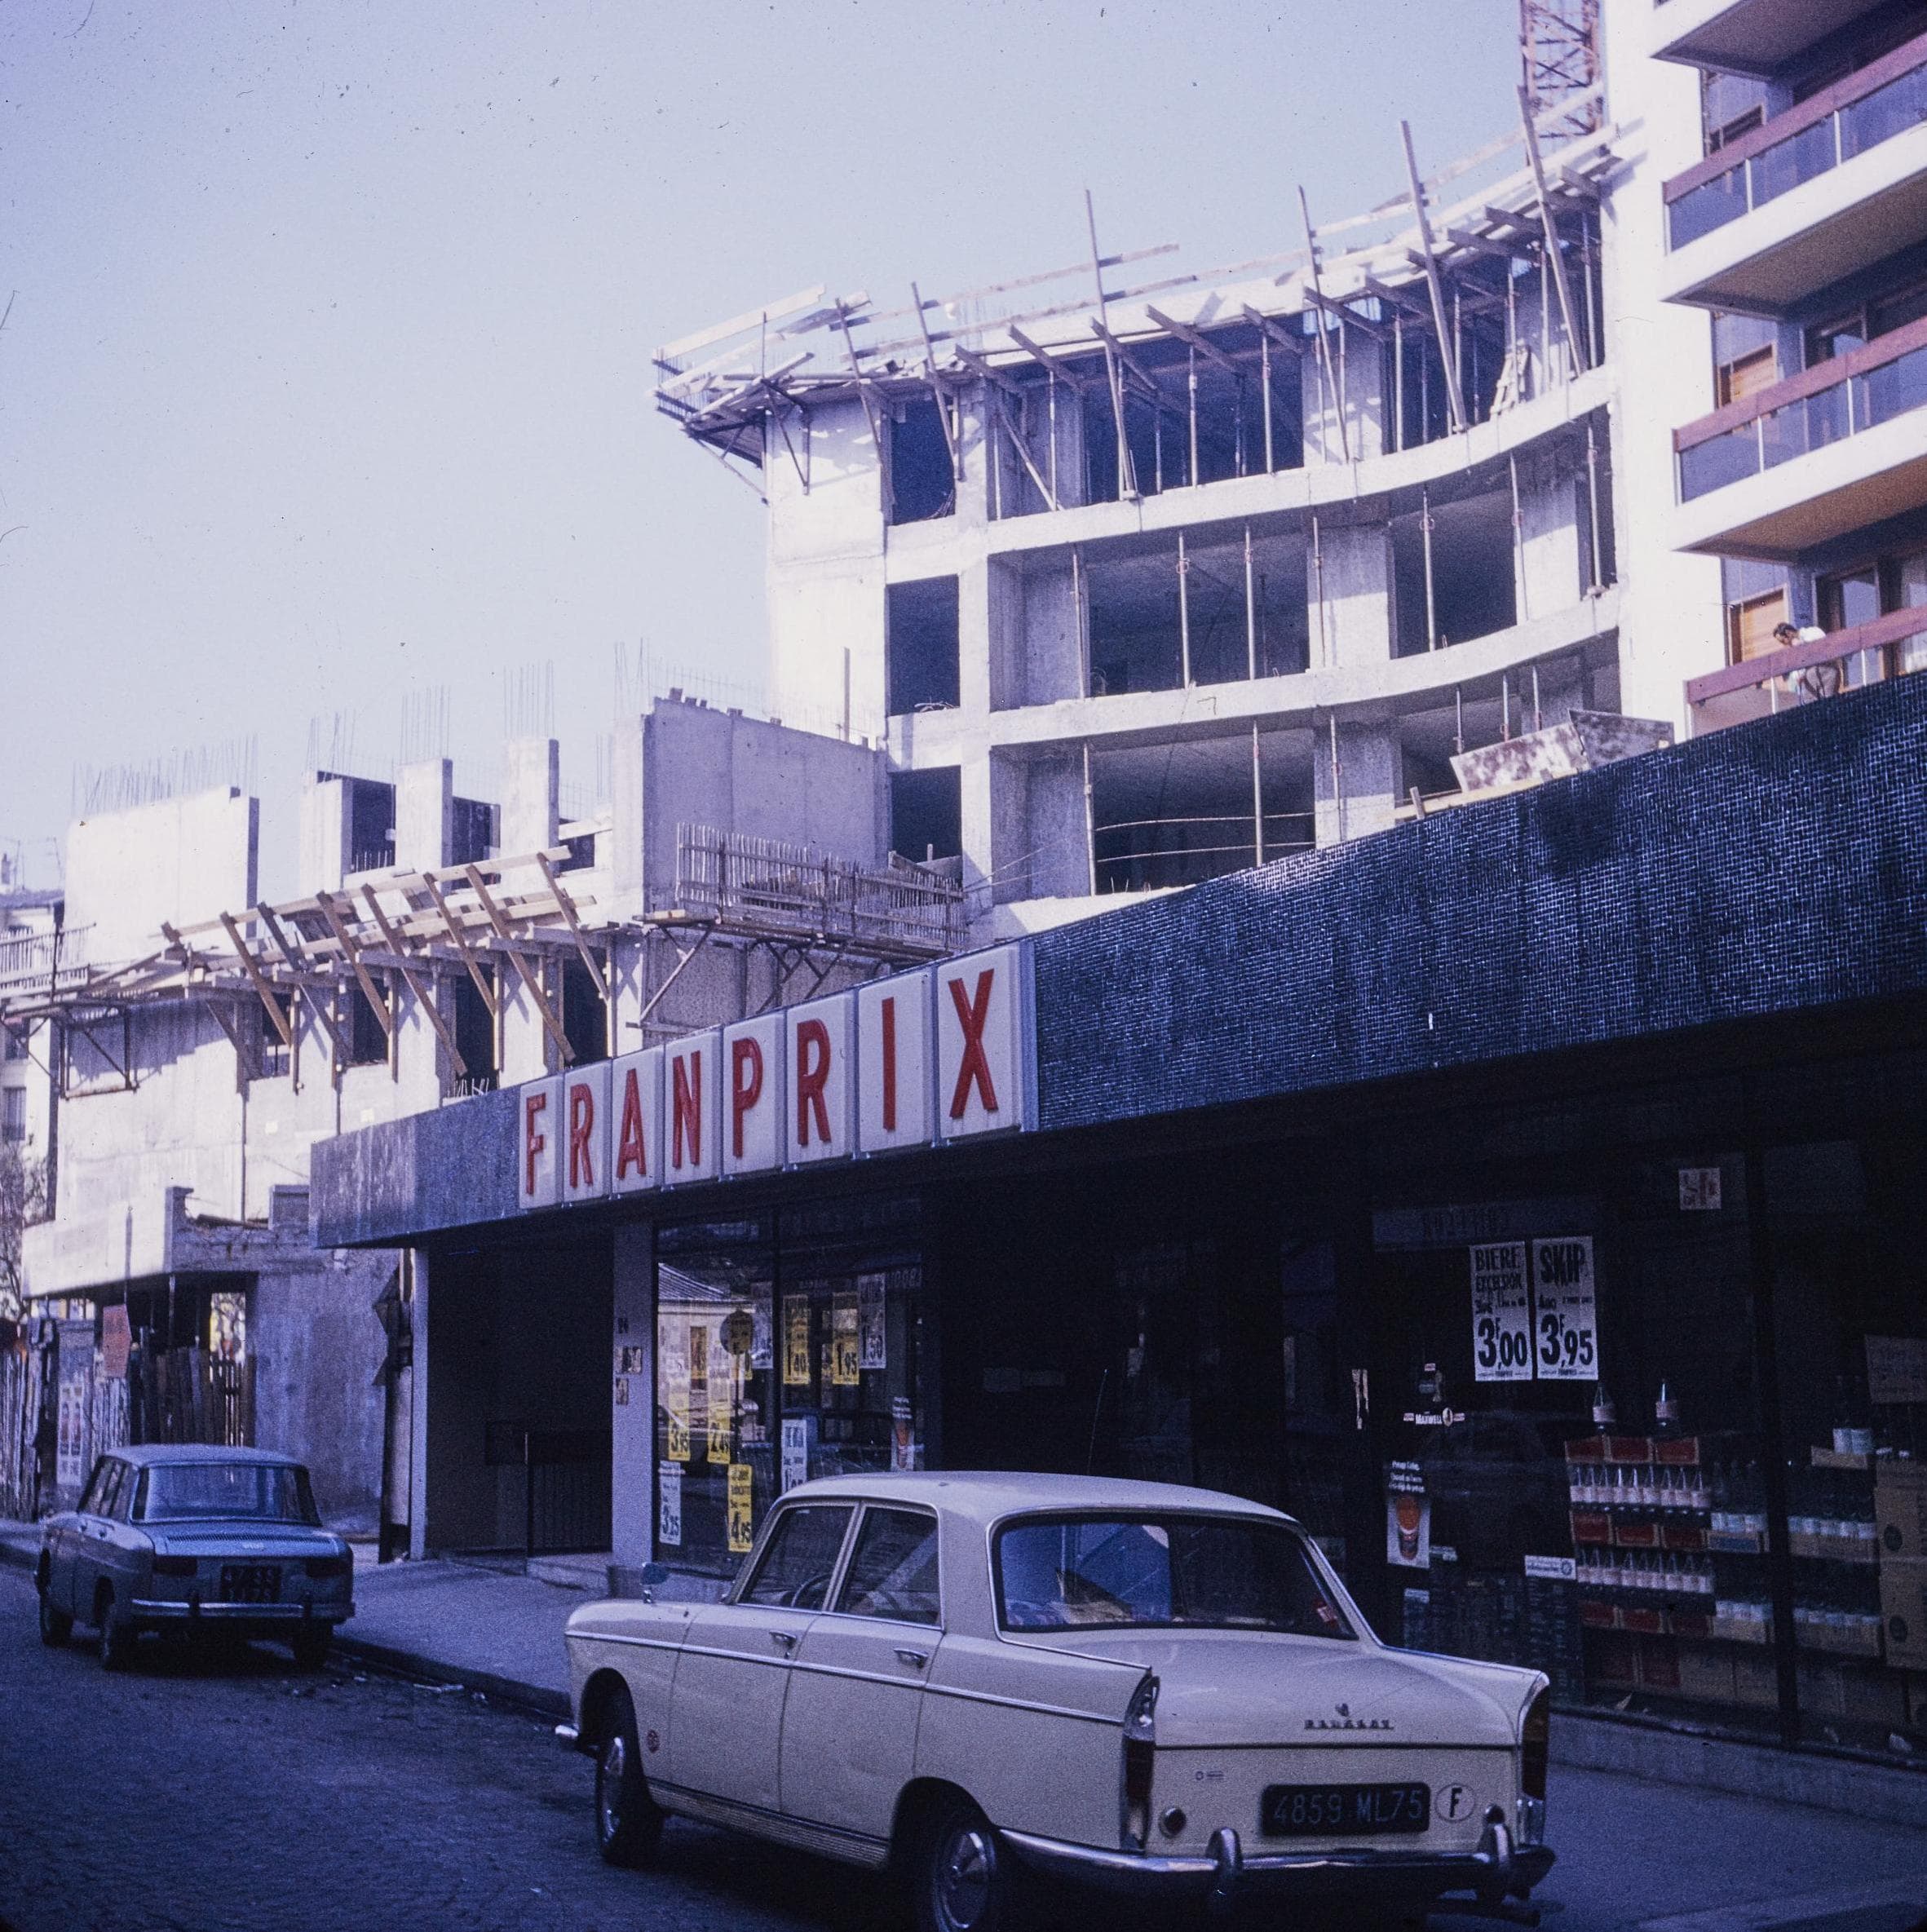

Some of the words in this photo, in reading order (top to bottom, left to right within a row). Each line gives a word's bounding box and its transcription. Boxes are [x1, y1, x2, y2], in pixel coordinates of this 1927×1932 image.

[526, 968, 998, 1196] FRANPRIX
[1475, 1246, 1521, 1271] BIERE
[1540, 1244, 1586, 1285] SKIP
[1273, 1793, 1343, 1824] 4859
[1449, 1787, 1463, 1818] F
